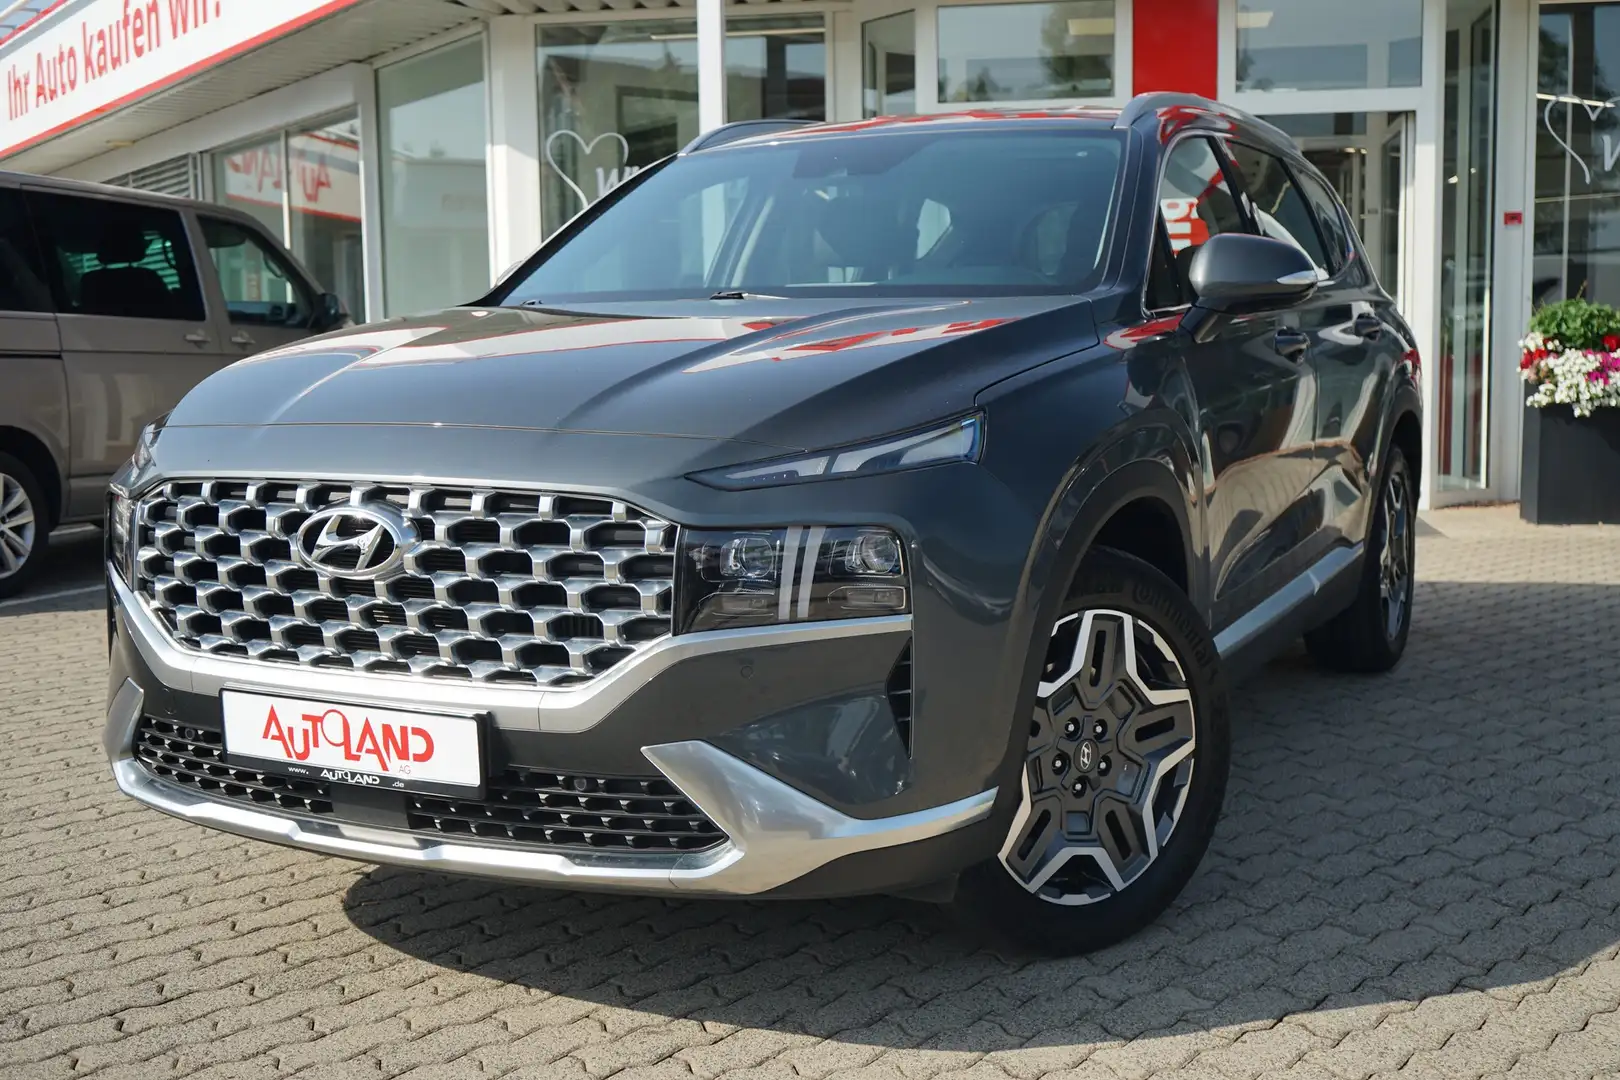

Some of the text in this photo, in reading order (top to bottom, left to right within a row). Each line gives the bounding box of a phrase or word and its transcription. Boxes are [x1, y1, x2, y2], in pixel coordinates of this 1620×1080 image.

[8, 64, 30, 120] Ihr
[35, 44, 78, 108] Auto
[82, 0, 161, 83] kaufen
[262, 704, 434, 772] AUTOLAND
[287, 766, 405, 788] www. AUTOLAND .de
[399, 764, 412, 775] AG
